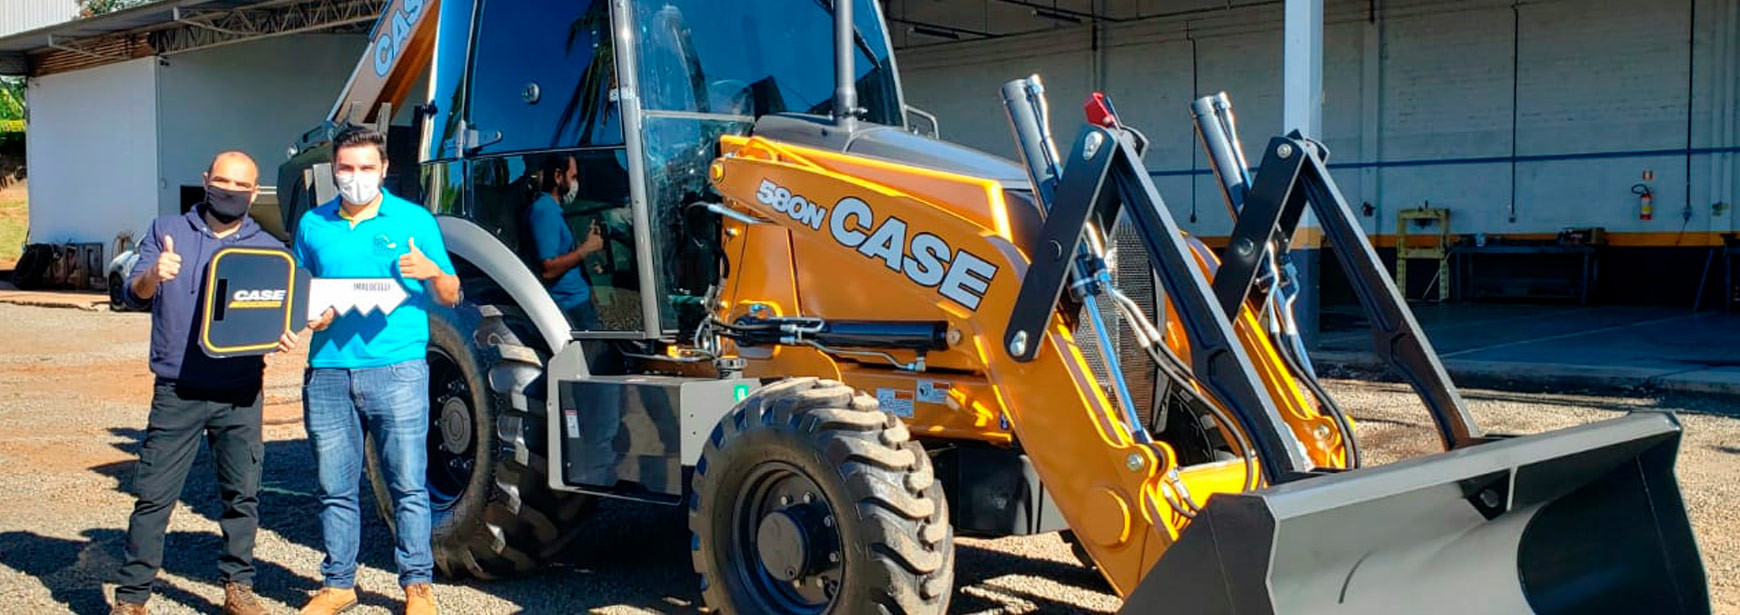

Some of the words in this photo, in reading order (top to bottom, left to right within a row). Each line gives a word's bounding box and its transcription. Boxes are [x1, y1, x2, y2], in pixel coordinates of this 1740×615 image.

[757, 178, 827, 230] 580N
[829, 196, 998, 311] CASE
[234, 289, 286, 301] CASE
